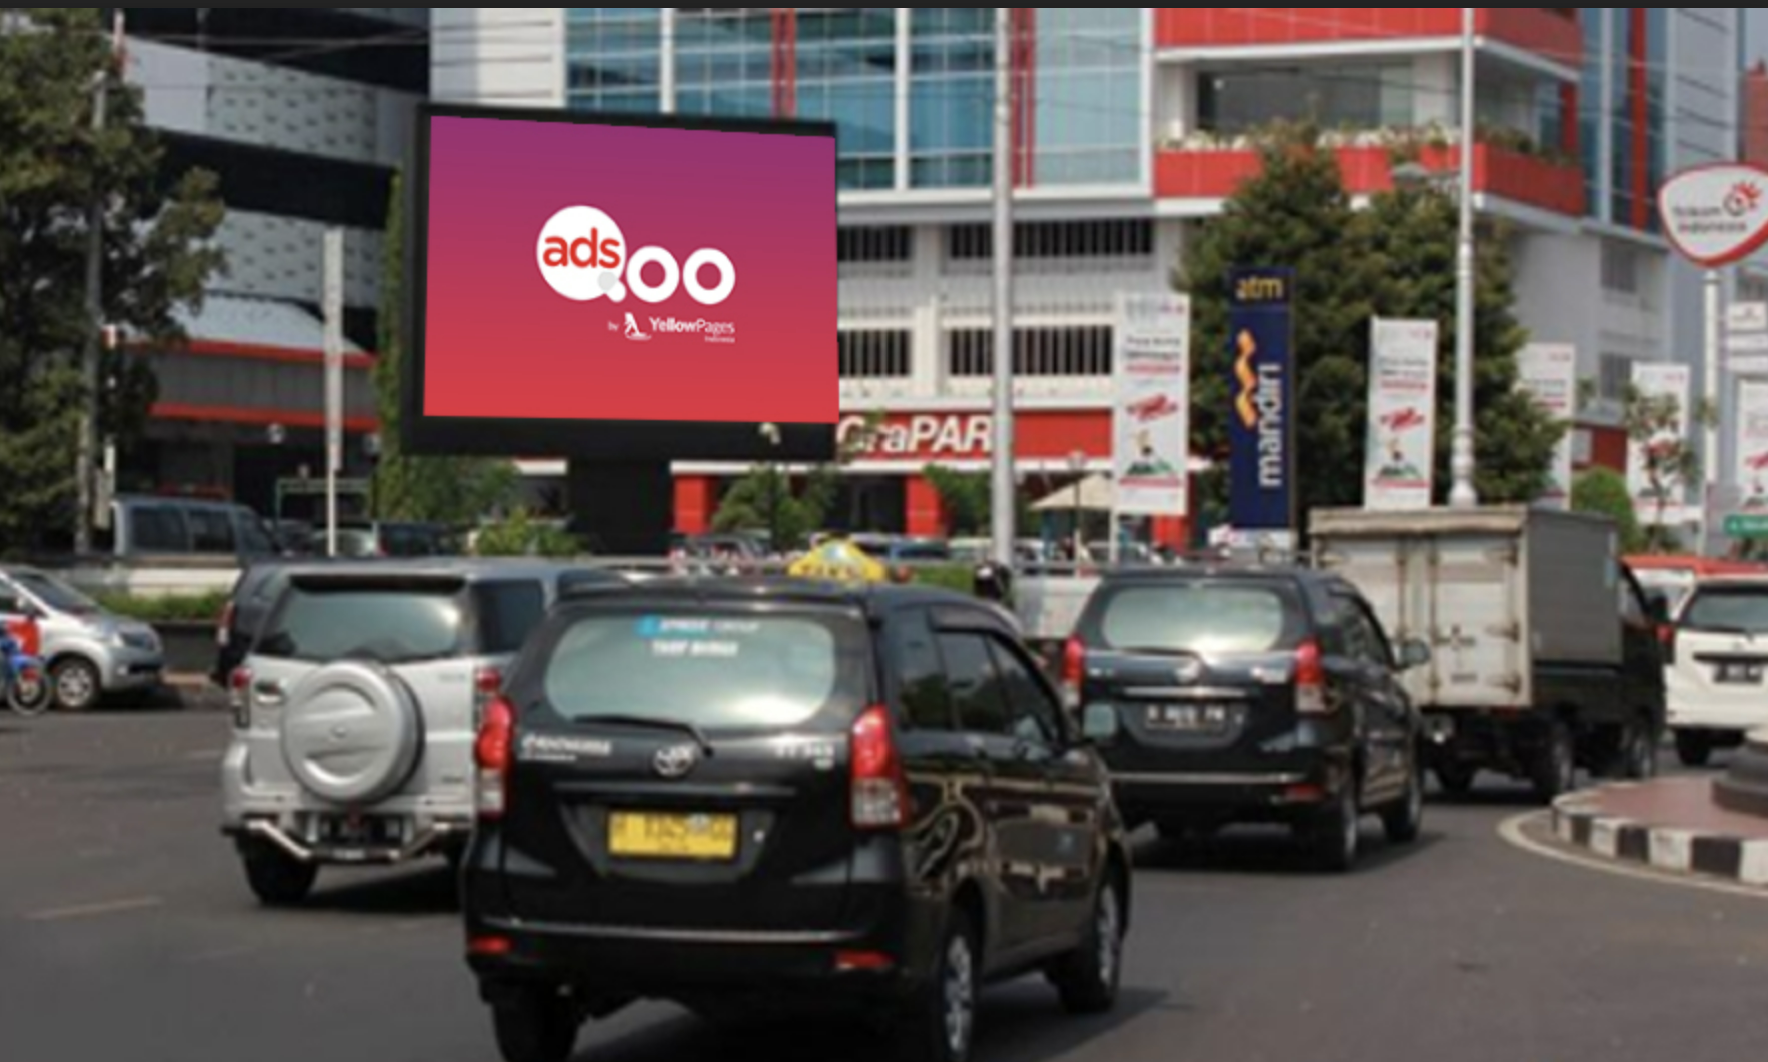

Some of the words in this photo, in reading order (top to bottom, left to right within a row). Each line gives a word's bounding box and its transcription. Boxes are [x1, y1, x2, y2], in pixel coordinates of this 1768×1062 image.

[1236, 276, 1283, 299] atm
[648, 316, 736, 337] YellowPages
[1254, 363, 1283, 488] mandiri
